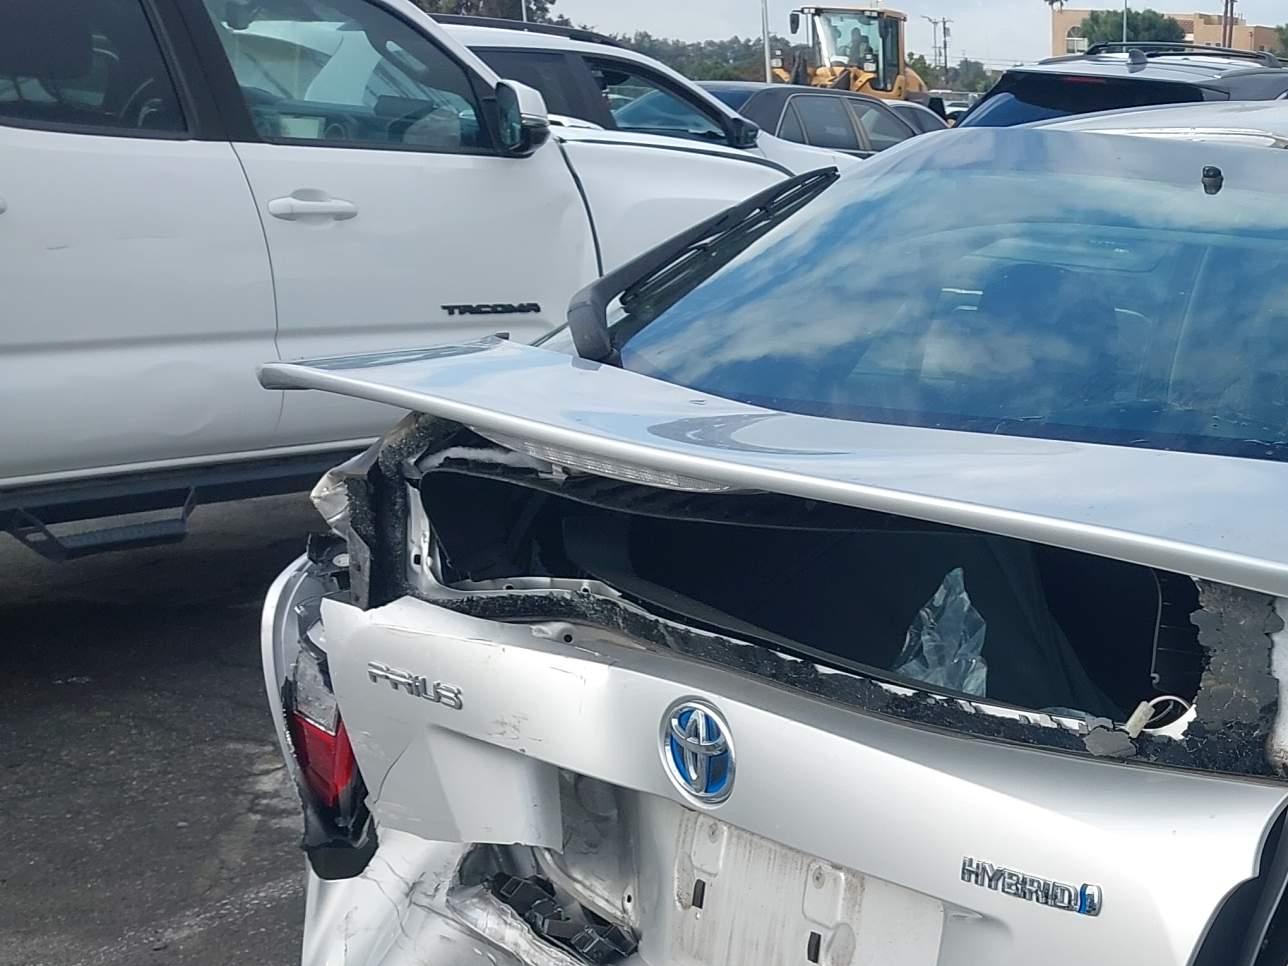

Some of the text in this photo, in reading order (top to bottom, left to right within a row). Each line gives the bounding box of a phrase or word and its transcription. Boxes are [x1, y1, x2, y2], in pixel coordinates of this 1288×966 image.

[441, 303, 541, 316] TACOMA
[367, 660, 463, 711] PRIUS
[960, 856, 1079, 912] HYBRID
